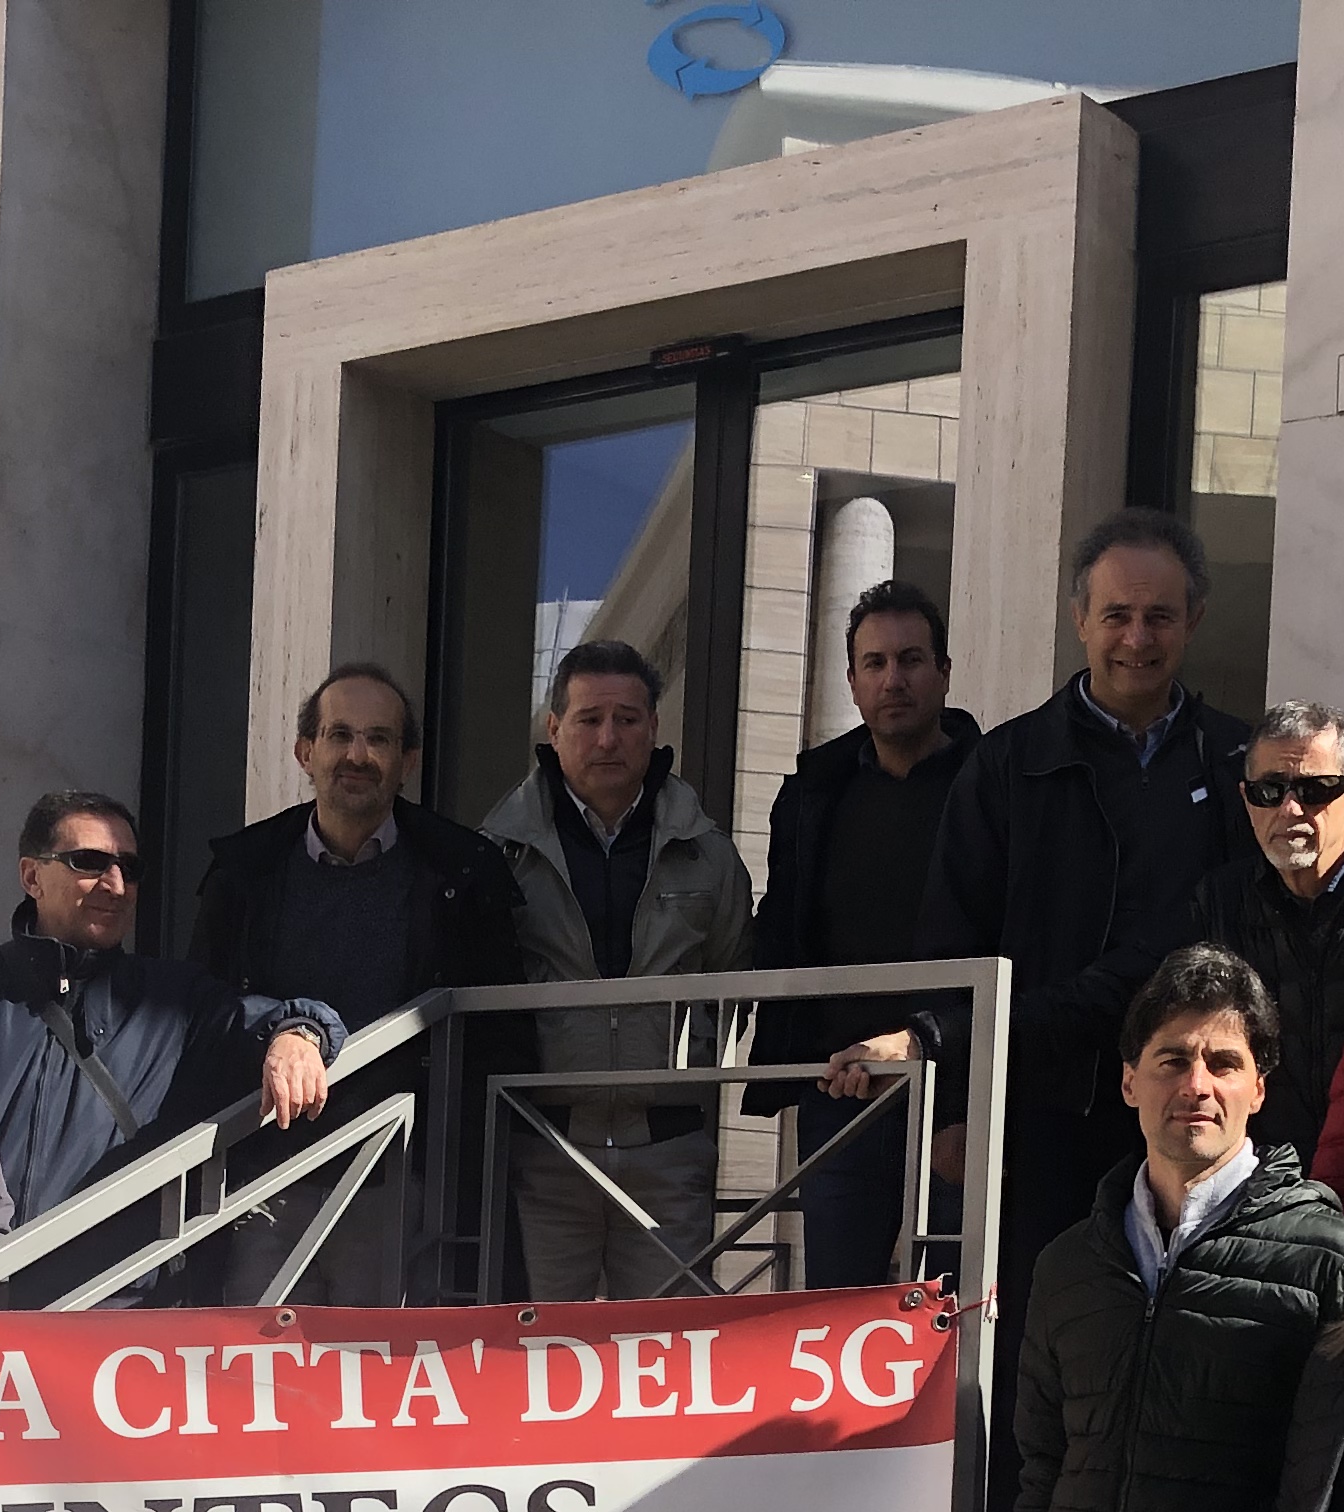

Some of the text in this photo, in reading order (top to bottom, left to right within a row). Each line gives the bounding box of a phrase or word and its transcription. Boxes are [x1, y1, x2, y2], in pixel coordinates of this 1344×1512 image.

[92, 1341, 484, 1439] CITTA'
[519, 1328, 755, 1422] DEL
[789, 1319, 924, 1413] 5G
